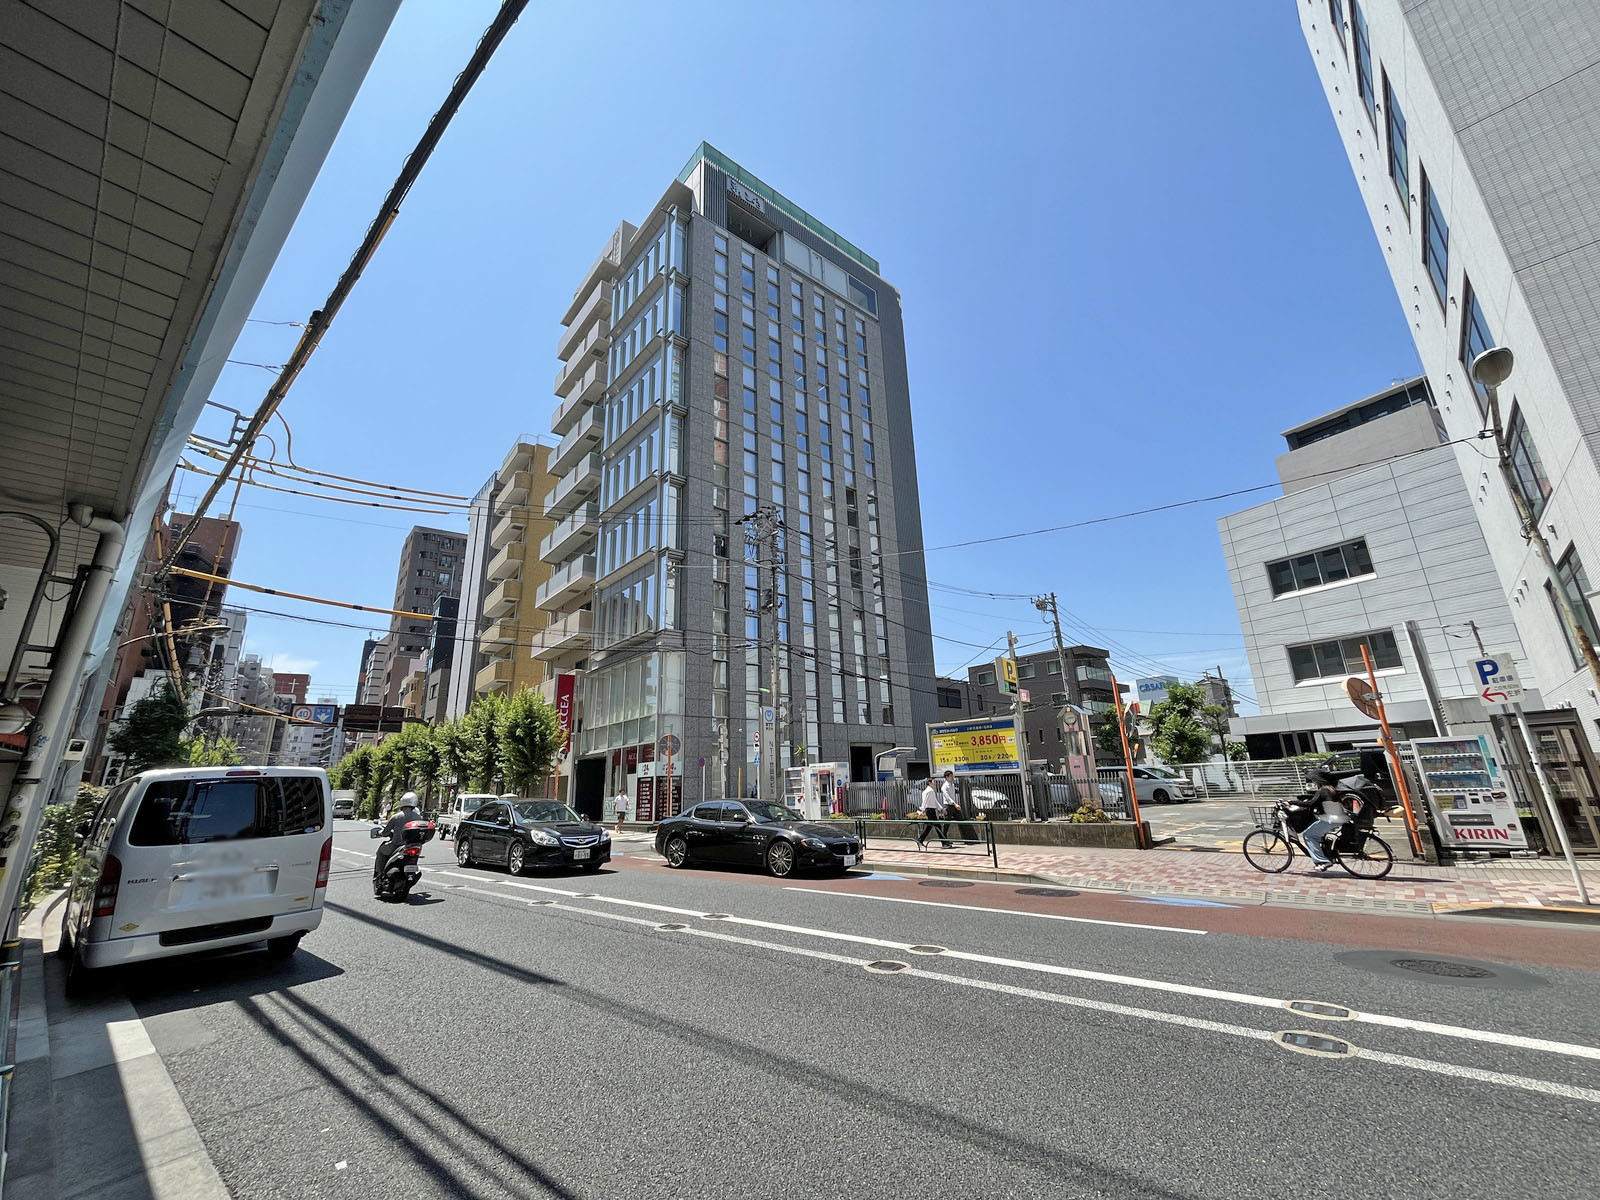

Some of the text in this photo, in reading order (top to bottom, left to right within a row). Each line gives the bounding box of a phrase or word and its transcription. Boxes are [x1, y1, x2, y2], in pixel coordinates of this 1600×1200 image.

[1006, 661, 1013, 680] P
[1475, 659, 1499, 685] P
[297, 710, 309, 718] 40
[559, 694, 570, 731] ACCEA
[970, 734, 1007, 747] 3,850円
[1453, 828, 1509, 840] KIRIN
